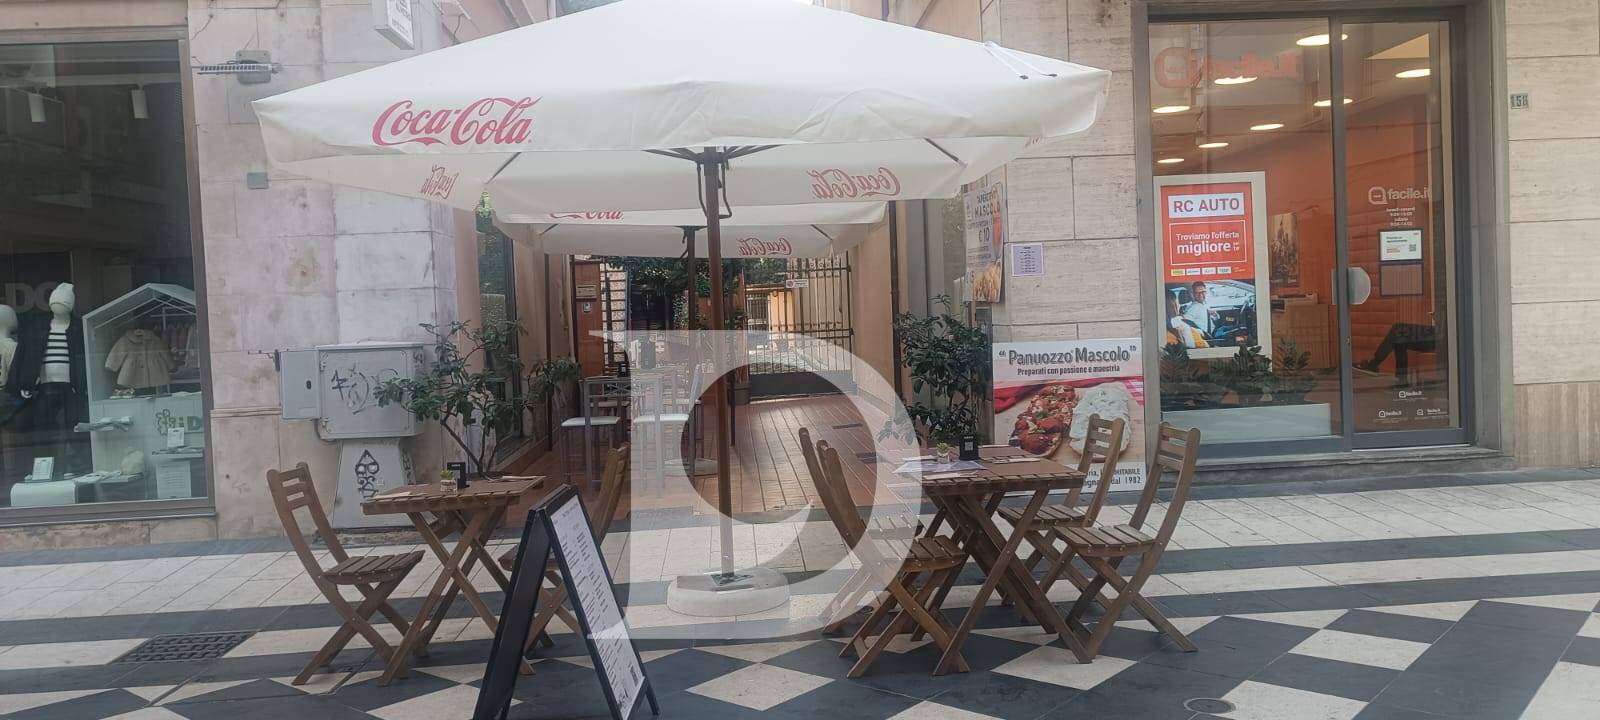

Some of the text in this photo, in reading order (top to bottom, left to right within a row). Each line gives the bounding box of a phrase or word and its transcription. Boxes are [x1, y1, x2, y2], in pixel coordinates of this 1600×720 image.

[372, 95, 542, 146] Coca-Cola
[1173, 198, 1240, 213] RC AUTO
[1176, 231, 1240, 241] Troviamo l'offerta
[1176, 241, 1231, 256] migliore
[1017, 366, 1047, 377] Preparati
[1047, 367, 1059, 375] con
[1059, 365, 1088, 376] passione
[1124, 475, 1141, 485] 1982
